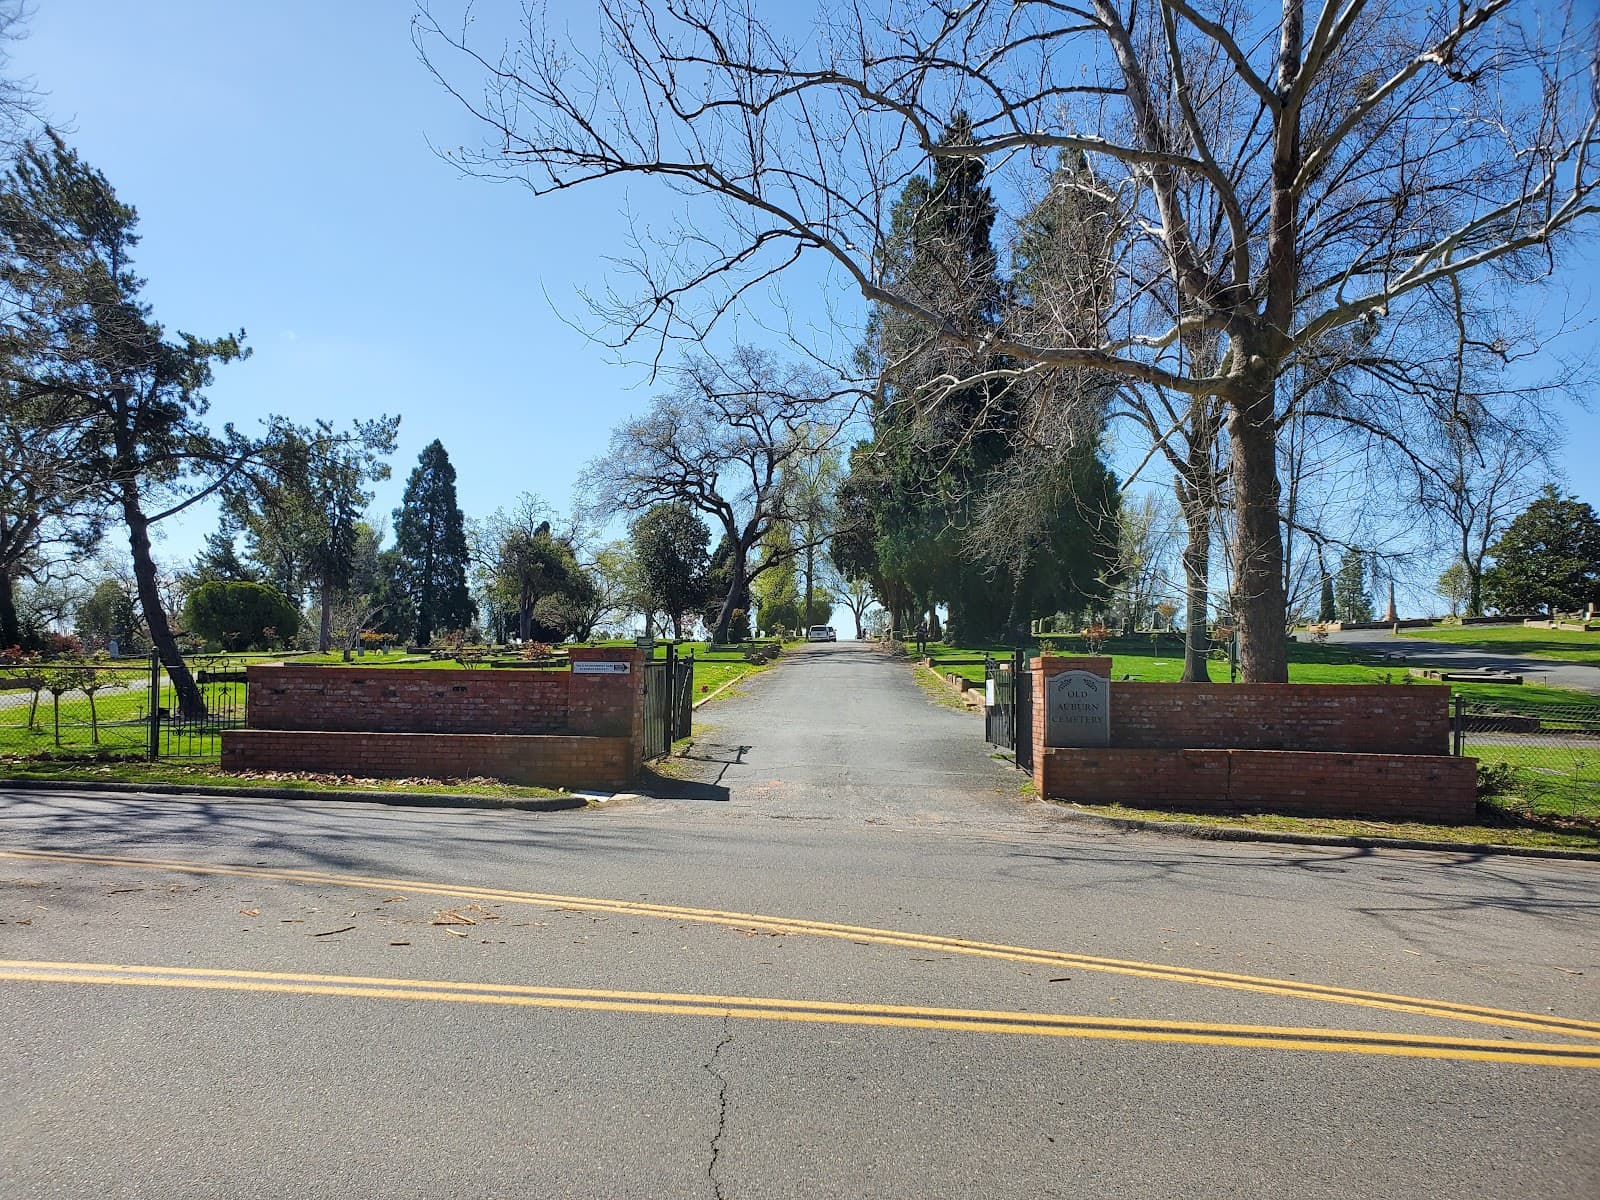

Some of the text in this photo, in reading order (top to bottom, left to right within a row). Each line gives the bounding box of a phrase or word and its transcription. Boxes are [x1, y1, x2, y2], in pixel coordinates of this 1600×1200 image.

[1067, 690, 1088, 698] OLD
[1057, 703, 1100, 711] AUBURN
[1051, 715, 1104, 724] CEMETERY
